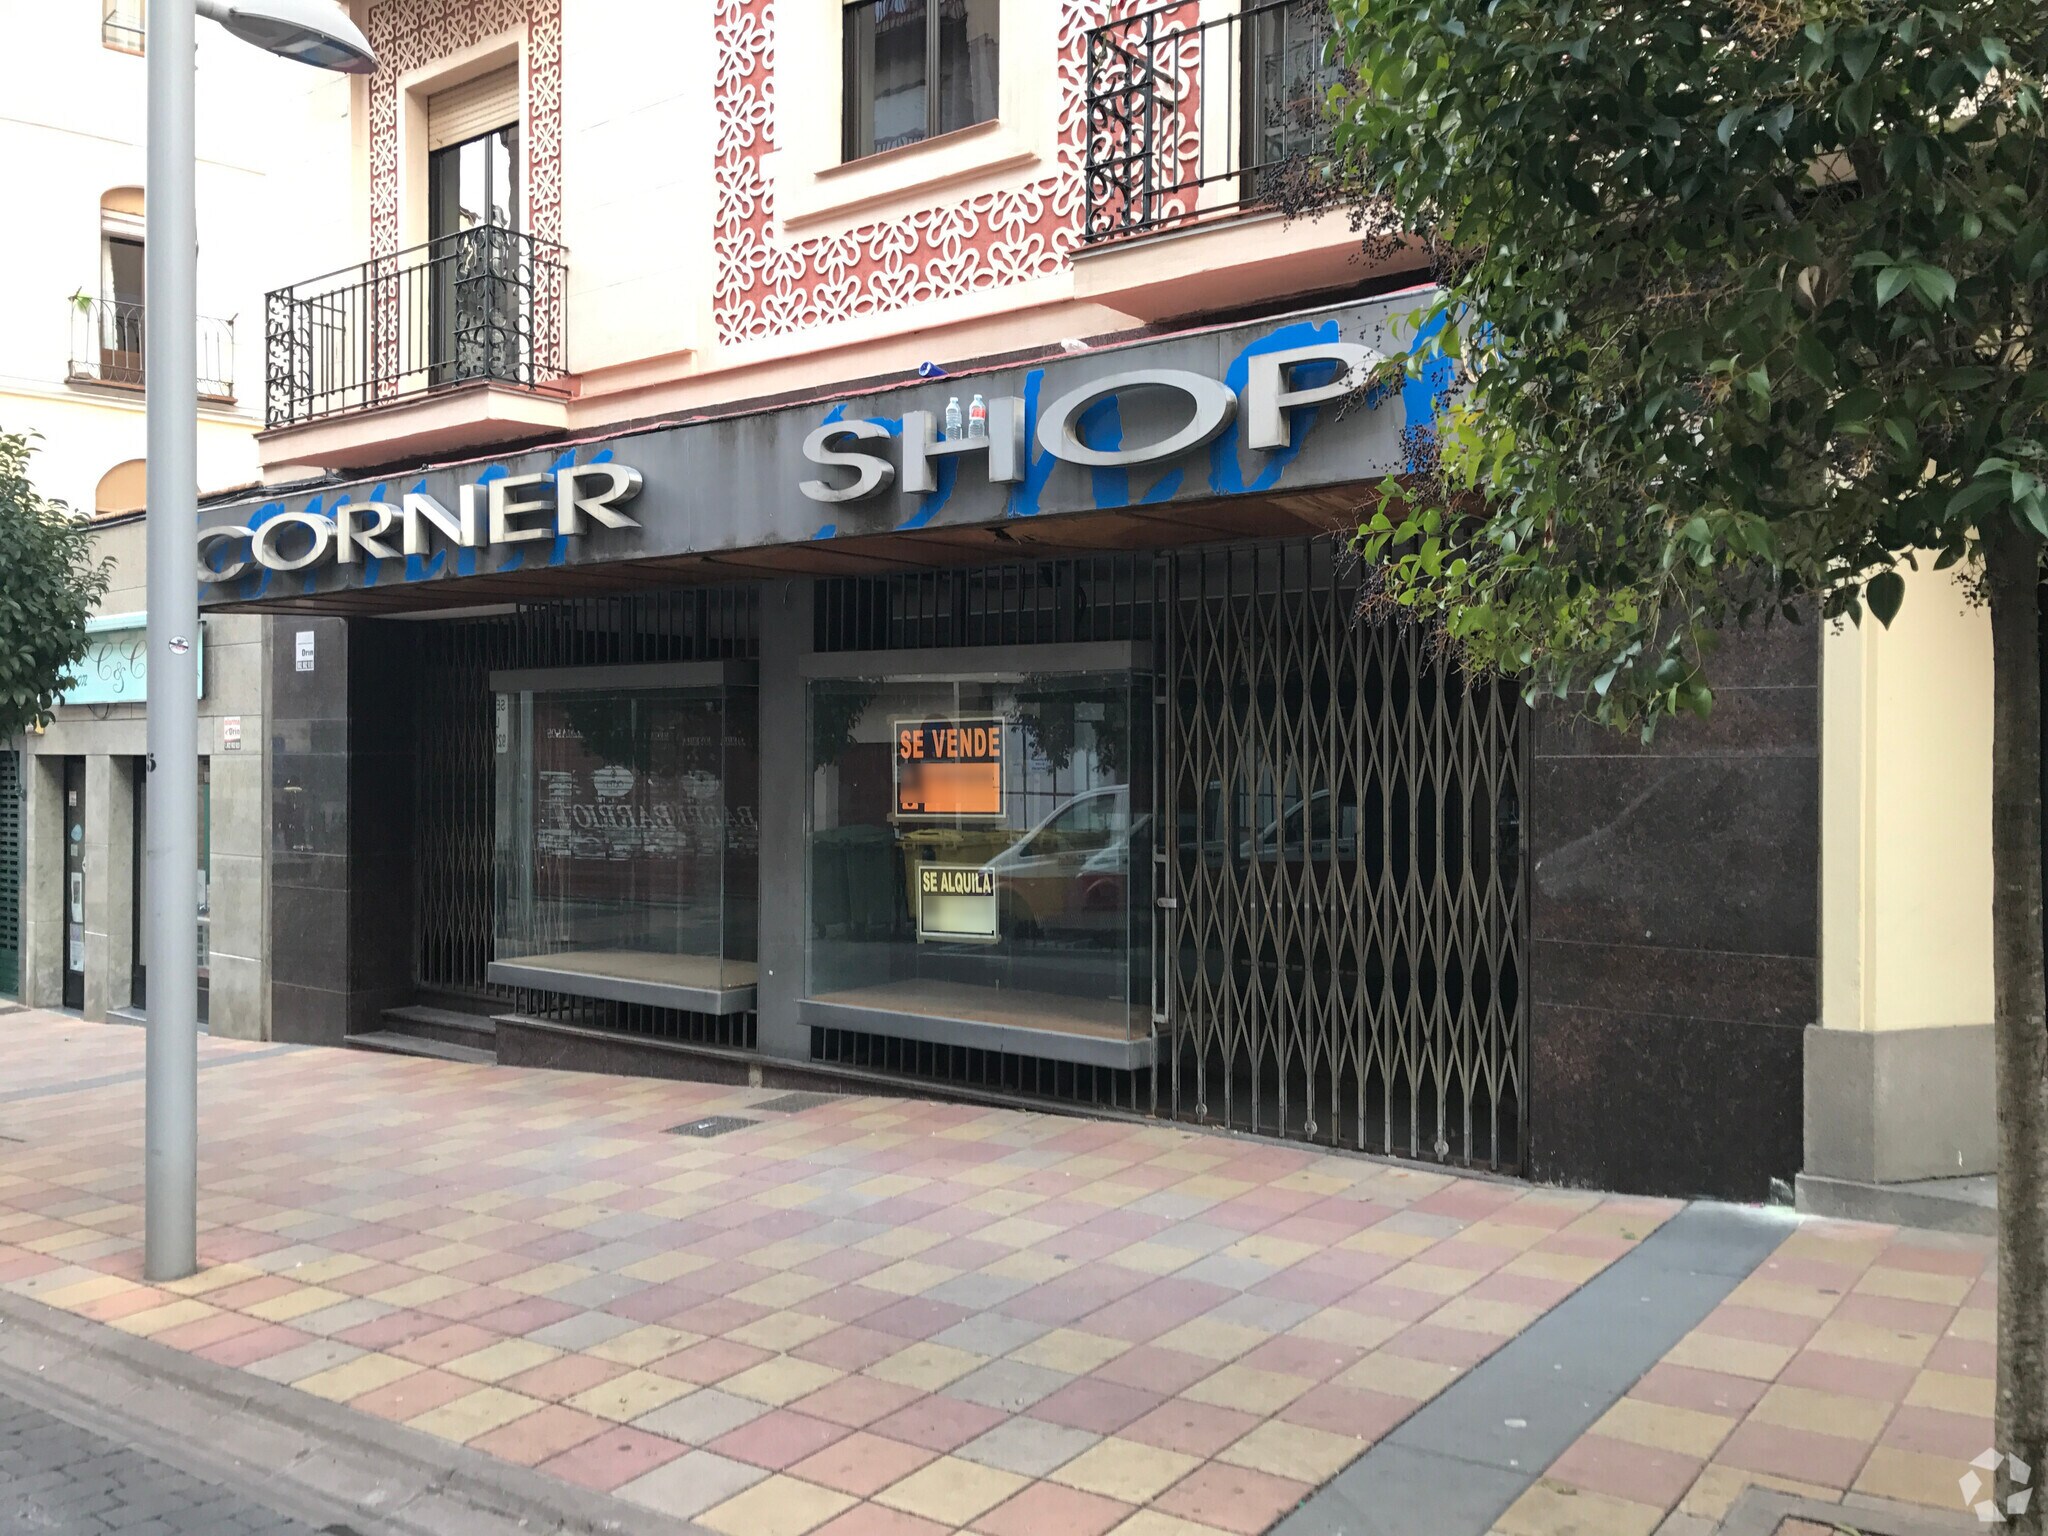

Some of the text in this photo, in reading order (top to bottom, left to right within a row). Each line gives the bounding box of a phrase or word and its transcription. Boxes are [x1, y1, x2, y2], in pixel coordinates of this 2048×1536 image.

[197, 342, 1389, 583] CORNER SHOP
[900, 727, 1000, 759] SE VENDE
[923, 871, 992, 894] SE ALQUILA
